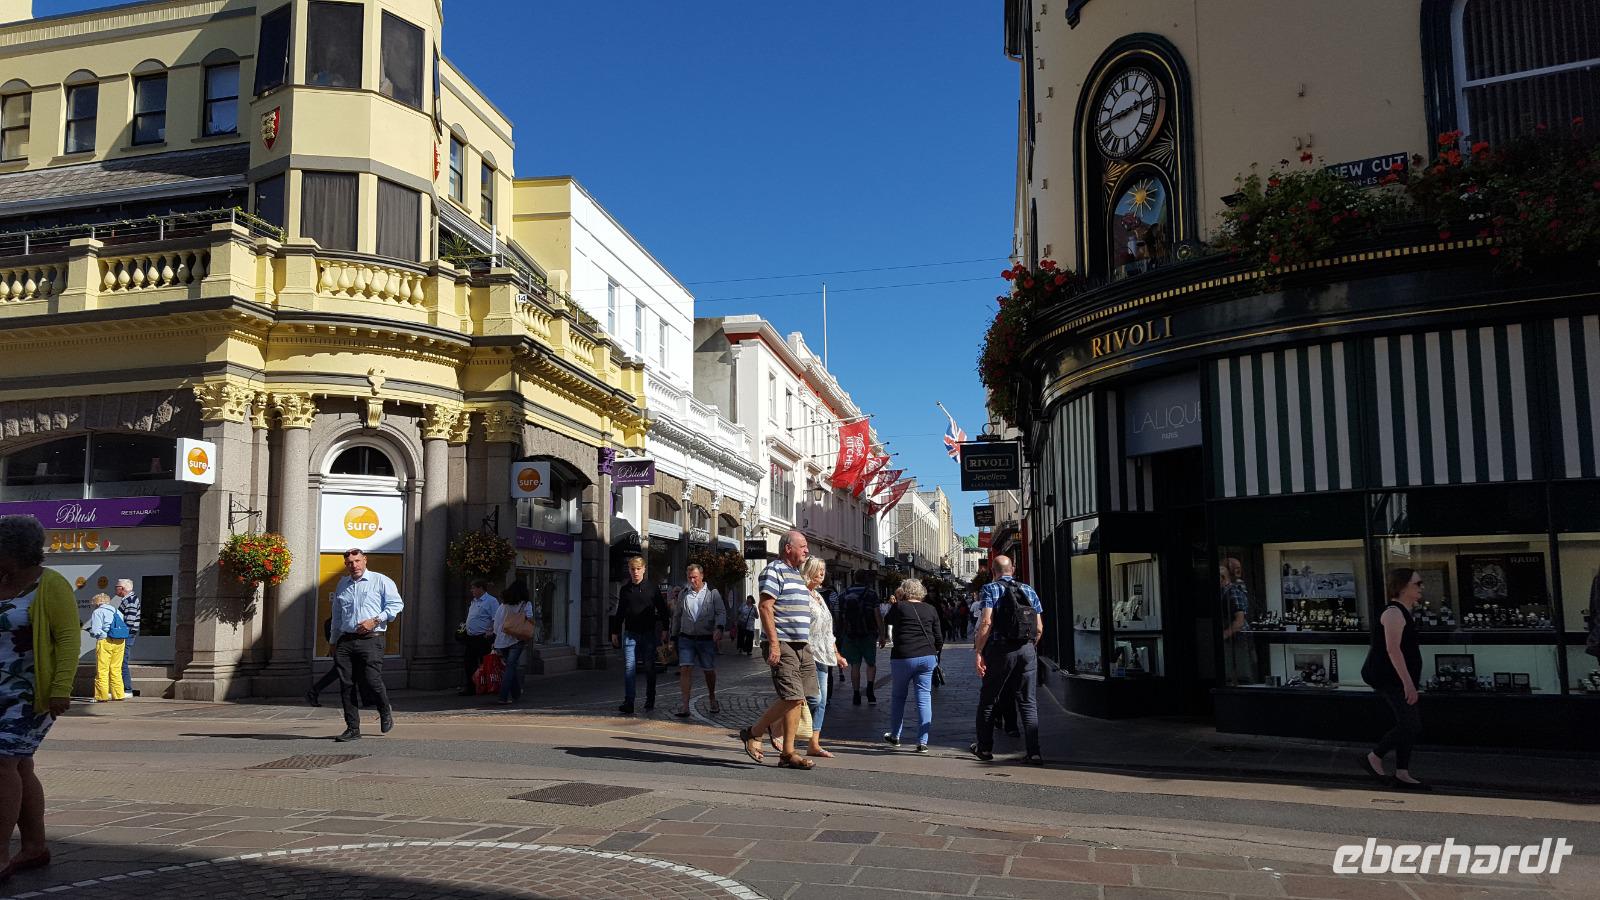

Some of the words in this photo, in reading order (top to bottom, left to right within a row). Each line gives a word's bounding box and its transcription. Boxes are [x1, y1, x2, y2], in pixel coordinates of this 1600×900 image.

[1327, 162, 1363, 178] NEW
[1371, 155, 1405, 174] CUT
[517, 294, 526, 302] 14
[1091, 315, 1174, 359] RIVOLI
[968, 458, 1009, 468] RIVOLI
[617, 465, 650, 480] Blush
[973, 473, 1008, 481] Jewellers
[56, 503, 97, 524] Blush
